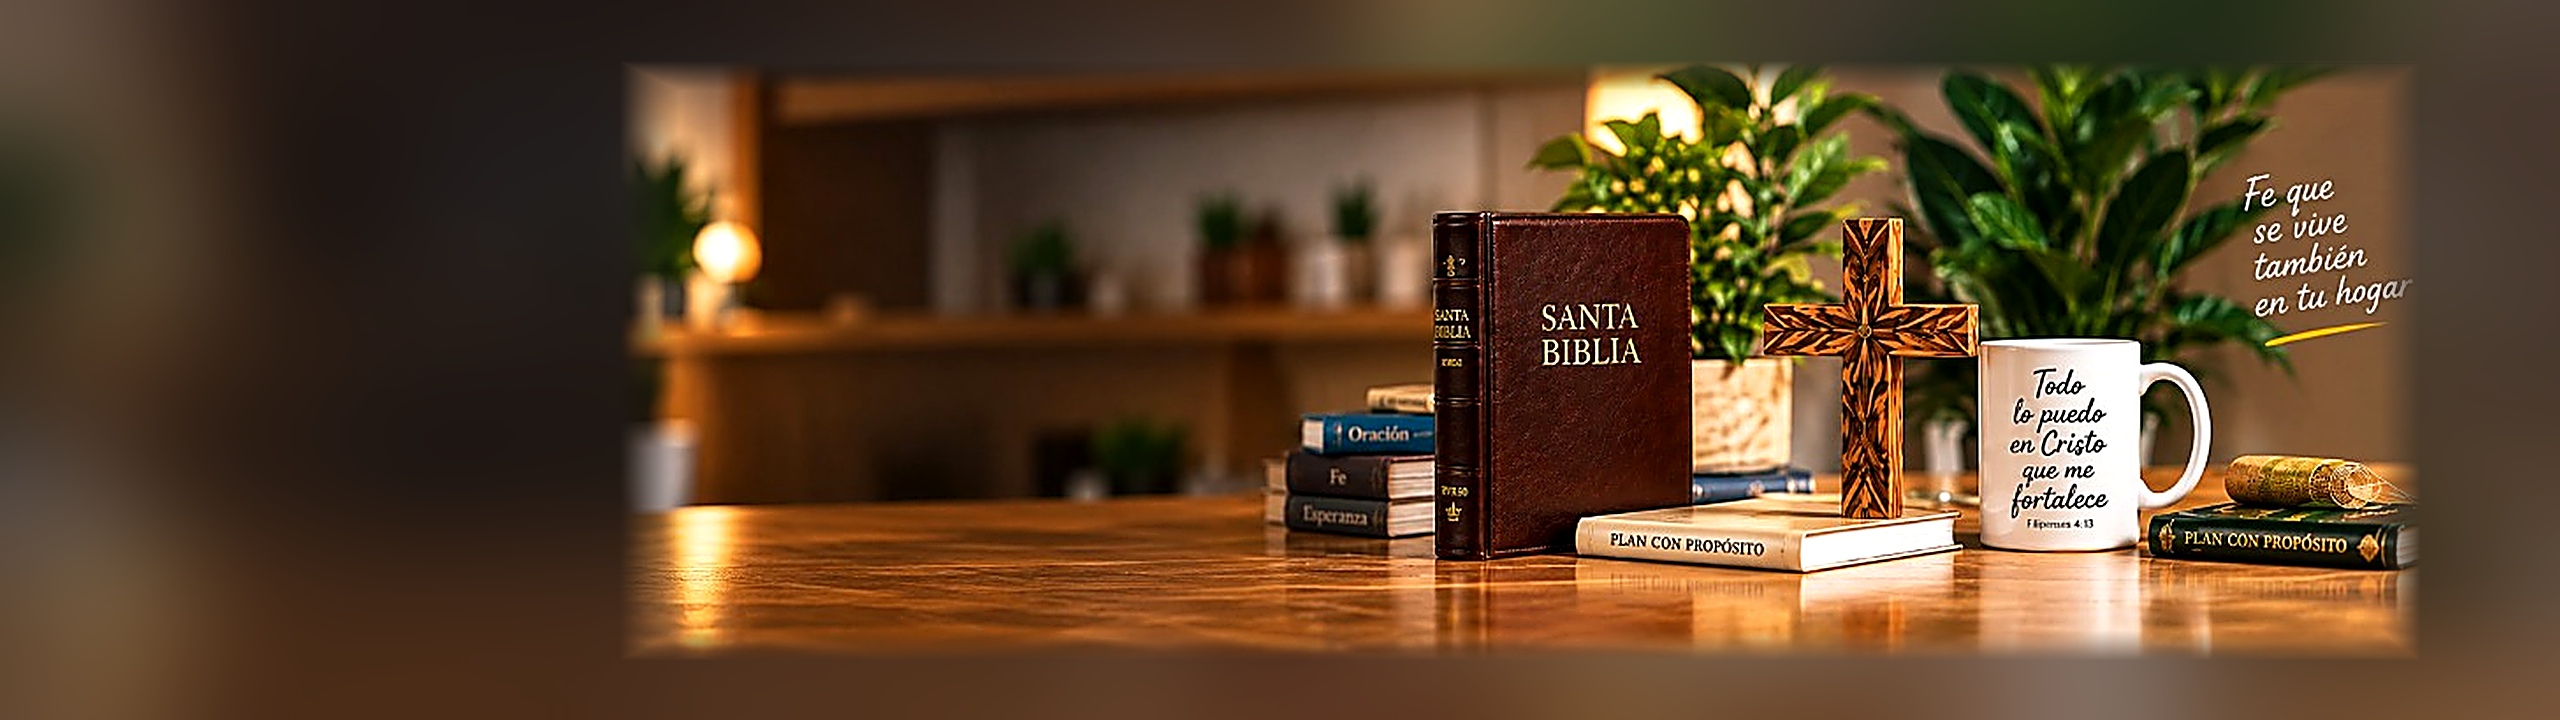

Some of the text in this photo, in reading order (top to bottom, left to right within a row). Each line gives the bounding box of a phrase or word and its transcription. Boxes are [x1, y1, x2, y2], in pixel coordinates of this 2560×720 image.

[1434, 309, 1470, 322] SANTA
[1541, 303, 1639, 332] SANTA
[1541, 337, 1642, 367] BIBLIA
[2033, 368, 2086, 399] Todo
[2013, 397, 2107, 434] lo puedo
[1348, 425, 1410, 442] Oración
[2010, 429, 2107, 457] en Cristo
[1329, 468, 1348, 485] Fe
[2022, 464, 2095, 488] que me
[2011, 483, 2109, 519] fortalece
[1303, 504, 1368, 528] Esperanza
[2074, 519, 2094, 528] 4:13
[1610, 533, 1765, 556] PLAN CON PROPÓSITO
[2184, 530, 2348, 553] PLAN CON PROPÓSITO
